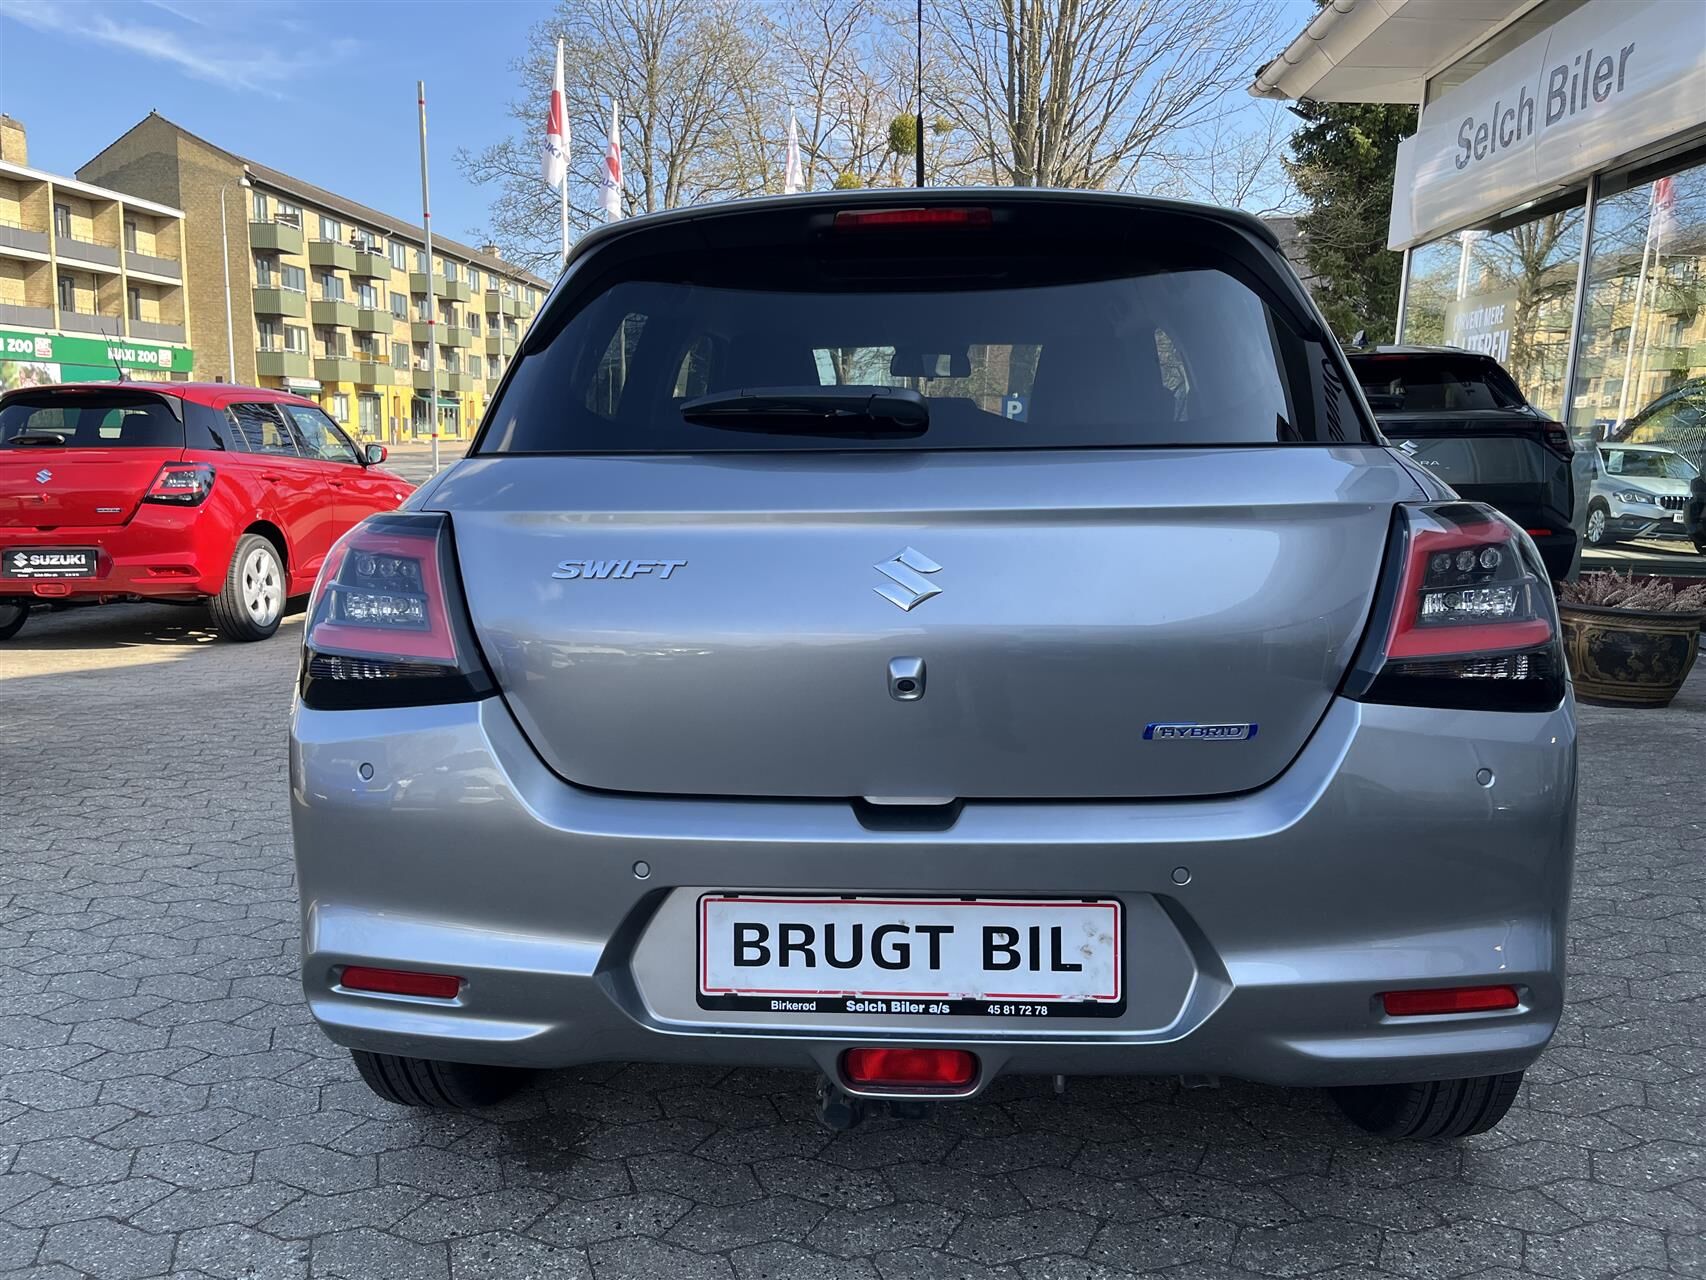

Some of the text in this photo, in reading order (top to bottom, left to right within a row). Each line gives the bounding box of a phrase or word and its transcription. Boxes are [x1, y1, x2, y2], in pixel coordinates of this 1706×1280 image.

[1455, 42, 1636, 170] Selch Biler
[1484, 304, 1505, 326] MERE
[7, 338, 33, 353] ZOO
[108, 347, 158, 363] MAXI ZOO
[1007, 400, 1023, 420] P
[30, 554, 86, 565] SUZUKI
[551, 559, 689, 580] SWIFT
[1160, 726, 1243, 738] HYBRID
[733, 922, 1083, 972] BRUGT BIL
[770, 1000, 817, 1011] Birkerød
[846, 1000, 950, 1014] Selch Biler a/s
[987, 1005, 1048, 1015] 45 81 72 78
